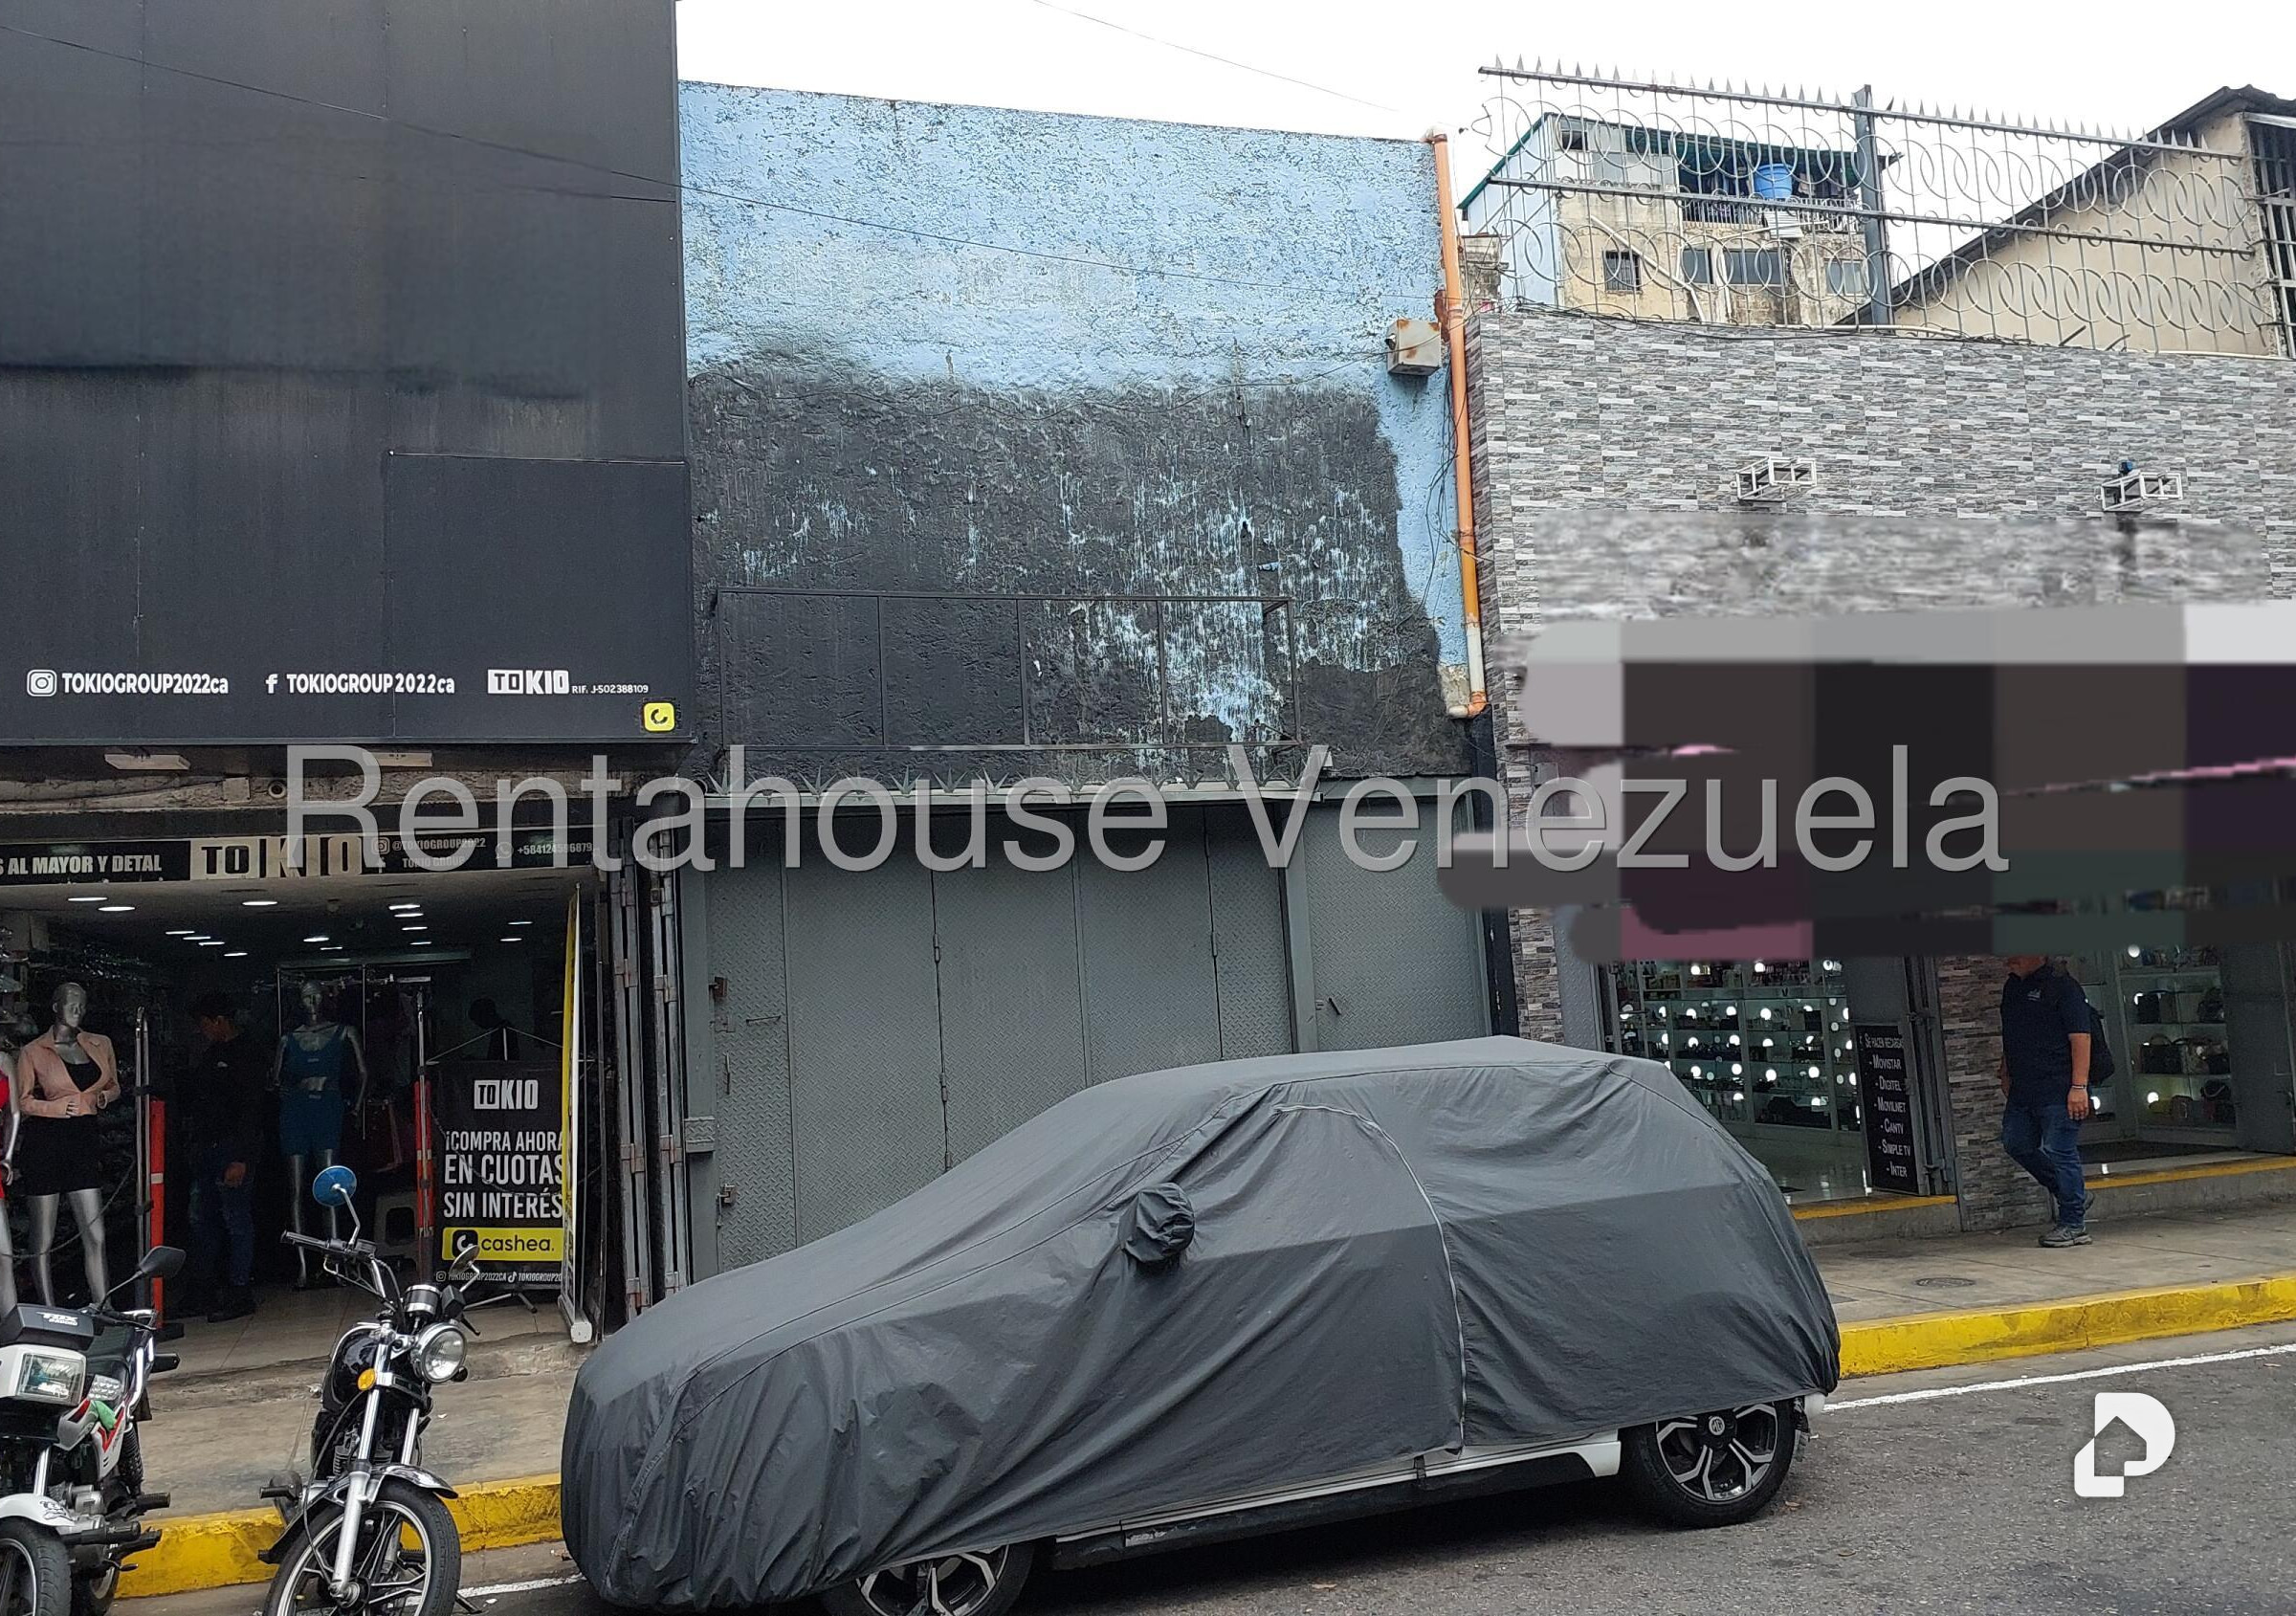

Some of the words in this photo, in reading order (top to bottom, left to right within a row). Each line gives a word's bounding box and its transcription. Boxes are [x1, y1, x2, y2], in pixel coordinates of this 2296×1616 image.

[62, 673, 229, 694] TOKIOGROUP2022ca
[287, 674, 455, 694] TOKIOGROUP2022ca
[488, 669, 569, 695] TOKIO
[590, 684, 649, 694] J-502388109
[8, 857, 29, 875] AL
[32, 855, 94, 874] MAYOR
[97, 854, 108, 873] Y
[112, 854, 163, 873] DETAL
[200, 833, 363, 878] TOKIO
[475, 1079, 539, 1110] TOKIO
[445, 1154, 474, 1184] EN
[481, 1154, 563, 1185] CUOTAS
[443, 1192, 475, 1218] SIN
[482, 1189, 563, 1219] INTERÉS
